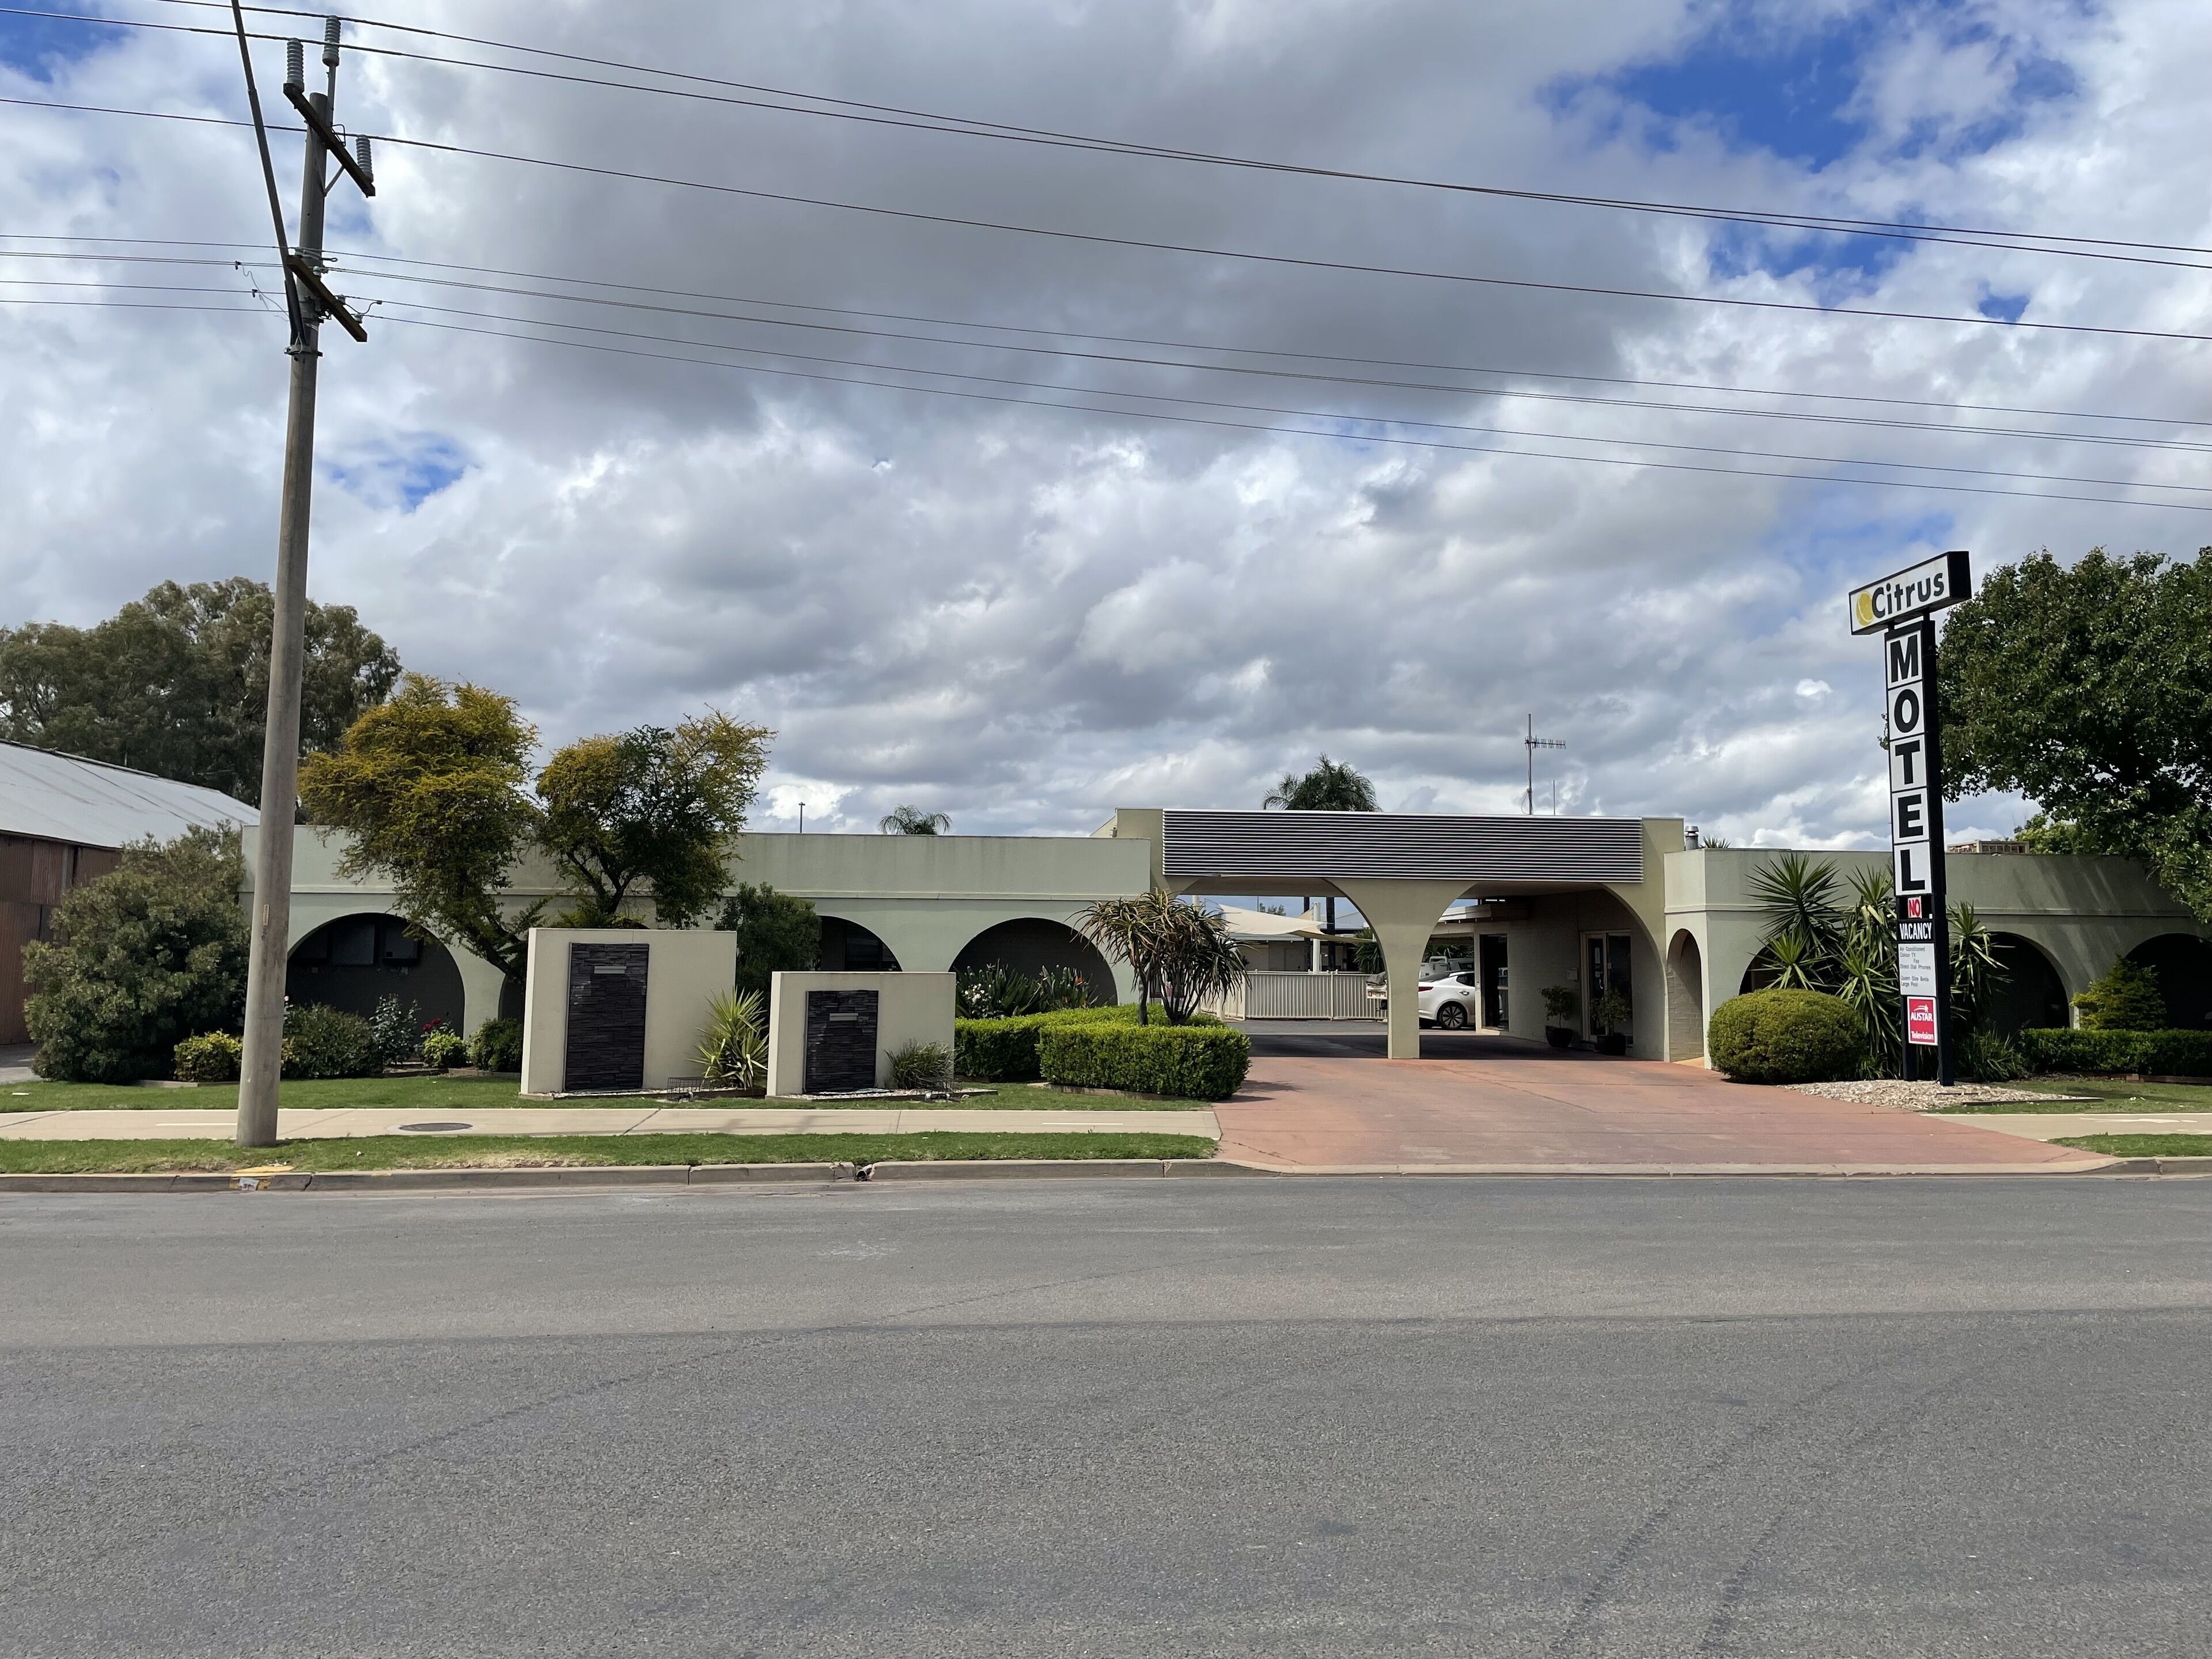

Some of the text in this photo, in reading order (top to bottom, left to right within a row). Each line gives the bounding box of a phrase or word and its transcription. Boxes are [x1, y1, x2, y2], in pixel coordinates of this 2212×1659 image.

[1872, 573, 1944, 619] Citrus
[1890, 634, 1925, 892] MOTEL
[1909, 899, 1921, 917] NO
[1899, 923, 1932, 940] VACANCY
[1910, 1012, 1933, 1021] AUSTAR
[1911, 1031, 1934, 1040] Television
